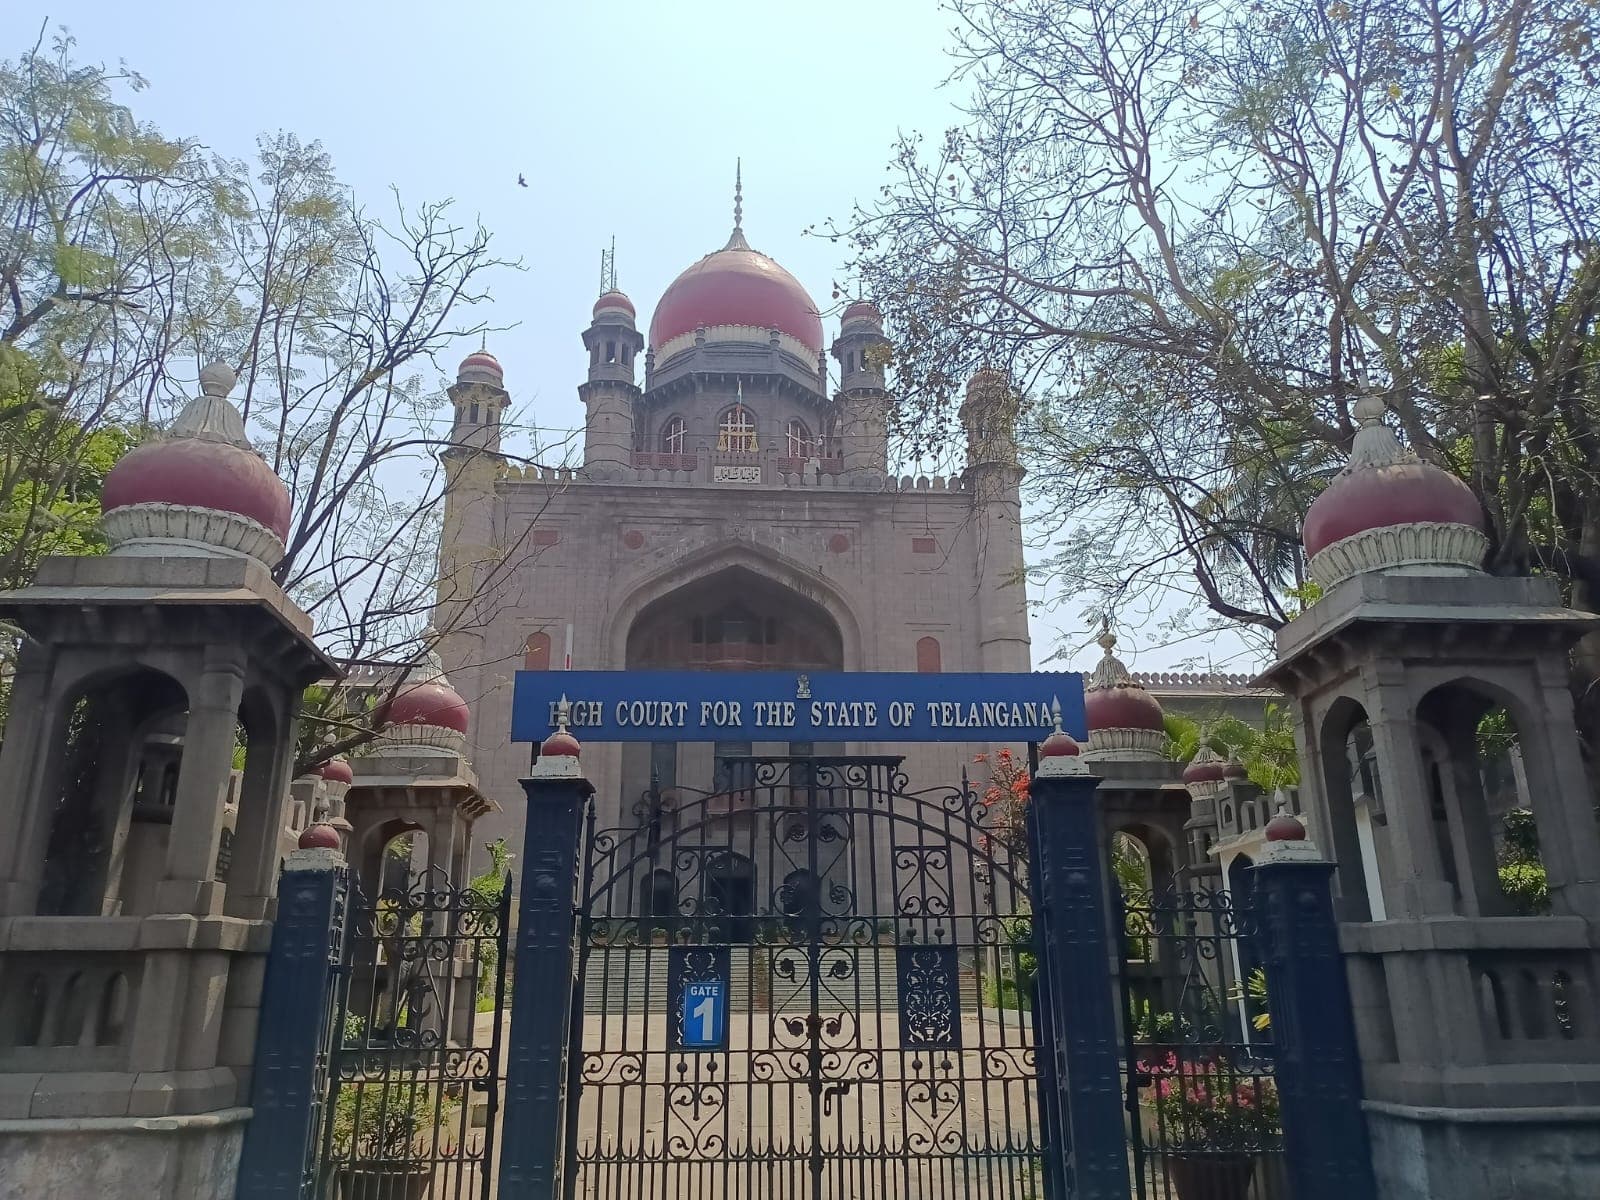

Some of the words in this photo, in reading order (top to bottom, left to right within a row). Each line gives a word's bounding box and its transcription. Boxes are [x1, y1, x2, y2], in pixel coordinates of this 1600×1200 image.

[548, 700, 603, 727] HIGH
[616, 701, 688, 727] COURT
[700, 701, 742, 727] FOR
[753, 701, 796, 727] THE
[810, 701, 878, 727] STATE
[888, 701, 915, 727] OF
[927, 701, 1054, 727] TELANGANA
[690, 986, 719, 996] GATE
[693, 997, 714, 1041] 1
